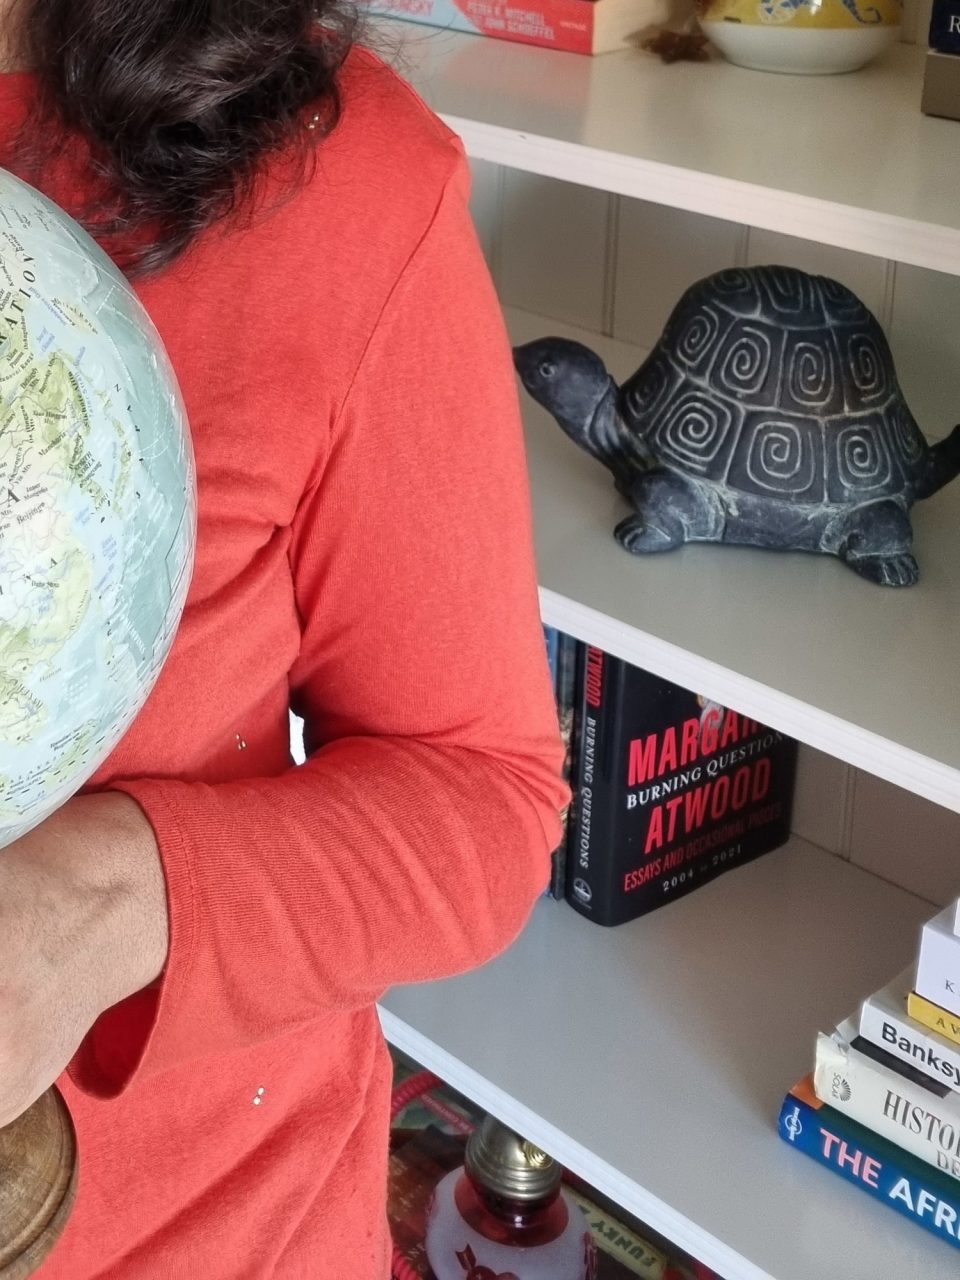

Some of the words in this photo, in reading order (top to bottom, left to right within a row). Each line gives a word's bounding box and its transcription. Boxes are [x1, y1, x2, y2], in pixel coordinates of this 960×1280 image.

[581, 716, 597, 783] BURNING
[626, 766, 702, 811] BURNING
[705, 730, 785, 778] QUESTION
[627, 708, 762, 788] MARGA
[579, 784, 594, 869] QUESTIONS
[644, 757, 772, 855] ATWOOD
[623, 858, 663, 893] ESSAYS
[662, 848, 685, 872] AND
[662, 869, 695, 893] 2004
[820, 1127, 883, 1190] THE
